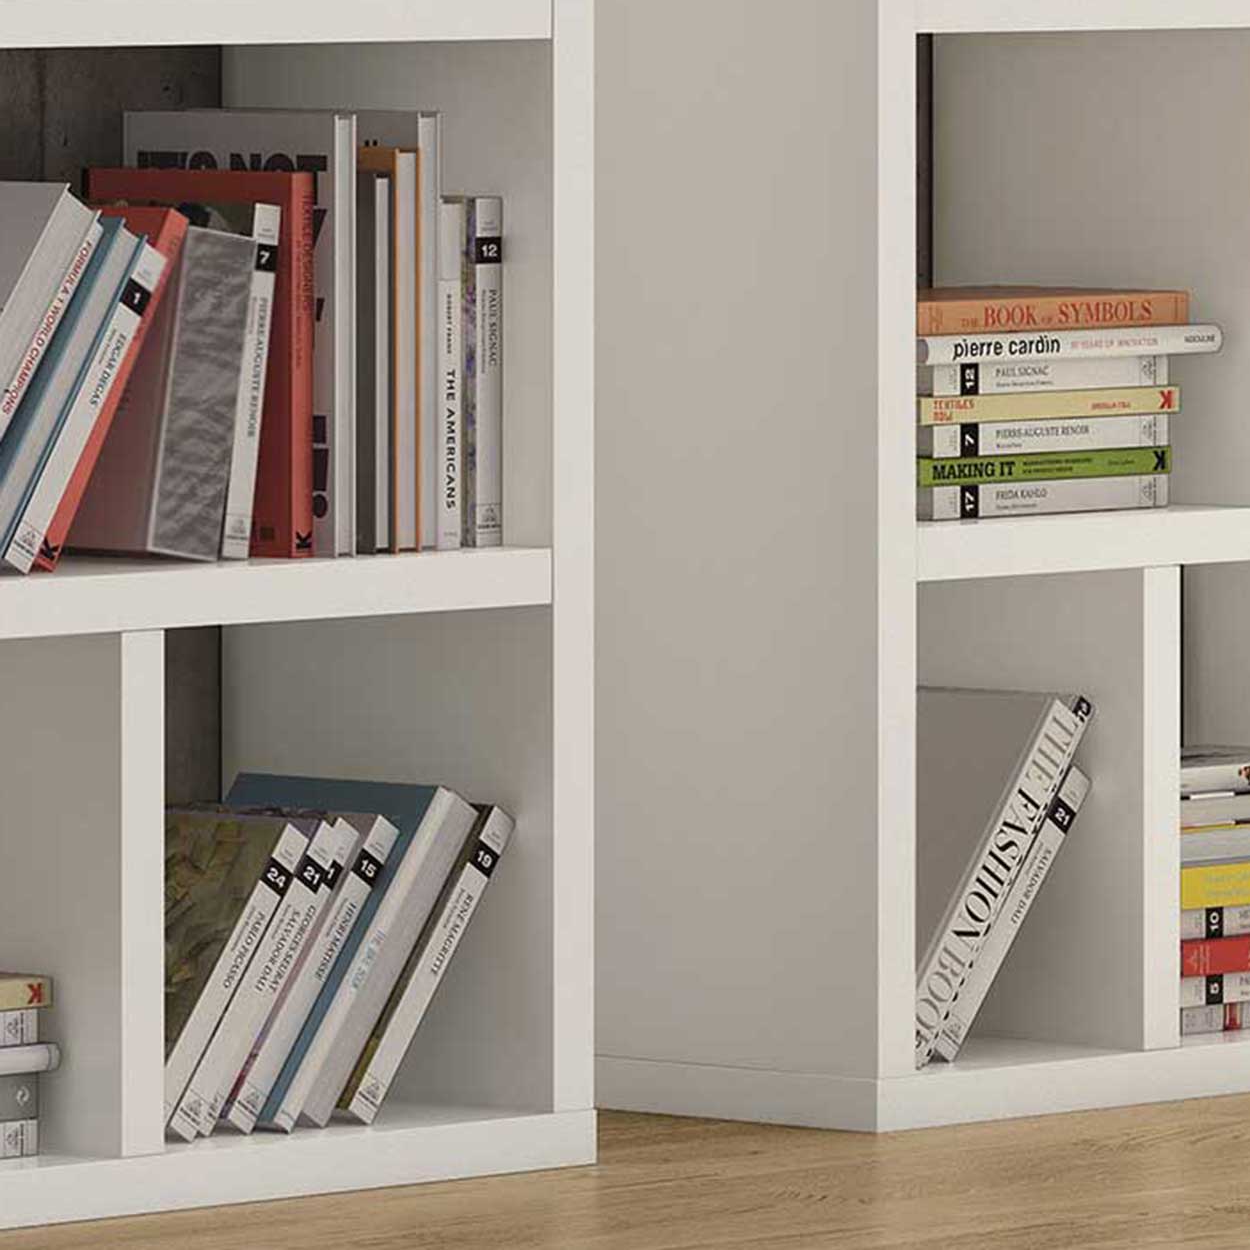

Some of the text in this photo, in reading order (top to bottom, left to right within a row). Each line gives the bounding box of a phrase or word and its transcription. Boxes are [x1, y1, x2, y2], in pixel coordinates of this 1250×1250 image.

[260, 251, 270, 264] 7
[482, 244, 498, 257] 12
[61, 240, 92, 295] FORMULA
[133, 292, 140, 304] 1
[37, 304, 61, 348] WORLD
[961, 318, 978, 328] THE
[983, 304, 1037, 327] BOOK
[1057, 301, 1152, 324] SYMBOLS
[488, 289, 497, 366] PAUL SIGNAC
[107, 333, 127, 370] EDGAR
[952, 335, 1061, 360] pierre cardin
[2, 346, 40, 415] CHAMPIONS
[965, 368, 975, 389] 12
[995, 365, 1050, 377] PAUL SIGNAC
[90, 368, 111, 407] DEGAS
[1159, 390, 1173, 409] K
[446, 369, 456, 509] THE AMERICANS
[965, 434, 975, 446] 7
[932, 462, 995, 480] MAKING
[999, 461, 1016, 477] IT
[1153, 450, 1165, 471] K
[965, 491, 975, 512] 17
[996, 490, 1019, 500] FRIDA
[296, 530, 312, 549] K
[1025, 716, 1079, 792] THE
[1054, 807, 1070, 826] 21
[361, 859, 376, 877] 15
[477, 850, 492, 868] 19
[951, 787, 1041, 952] FASHION
[267, 867, 286, 888] 24
[303, 866, 320, 885] 21
[1022, 849, 1052, 900] SALVADOR
[338, 902, 357, 934] HENRI
[1209, 911, 1219, 931] 10
[243, 912, 265, 948] PABLO
[271, 910, 301, 961] SALVADOR
[316, 931, 341, 980] MATISSE
[431, 922, 461, 975] MAGRITTE
[223, 946, 247, 989] PICASSO
